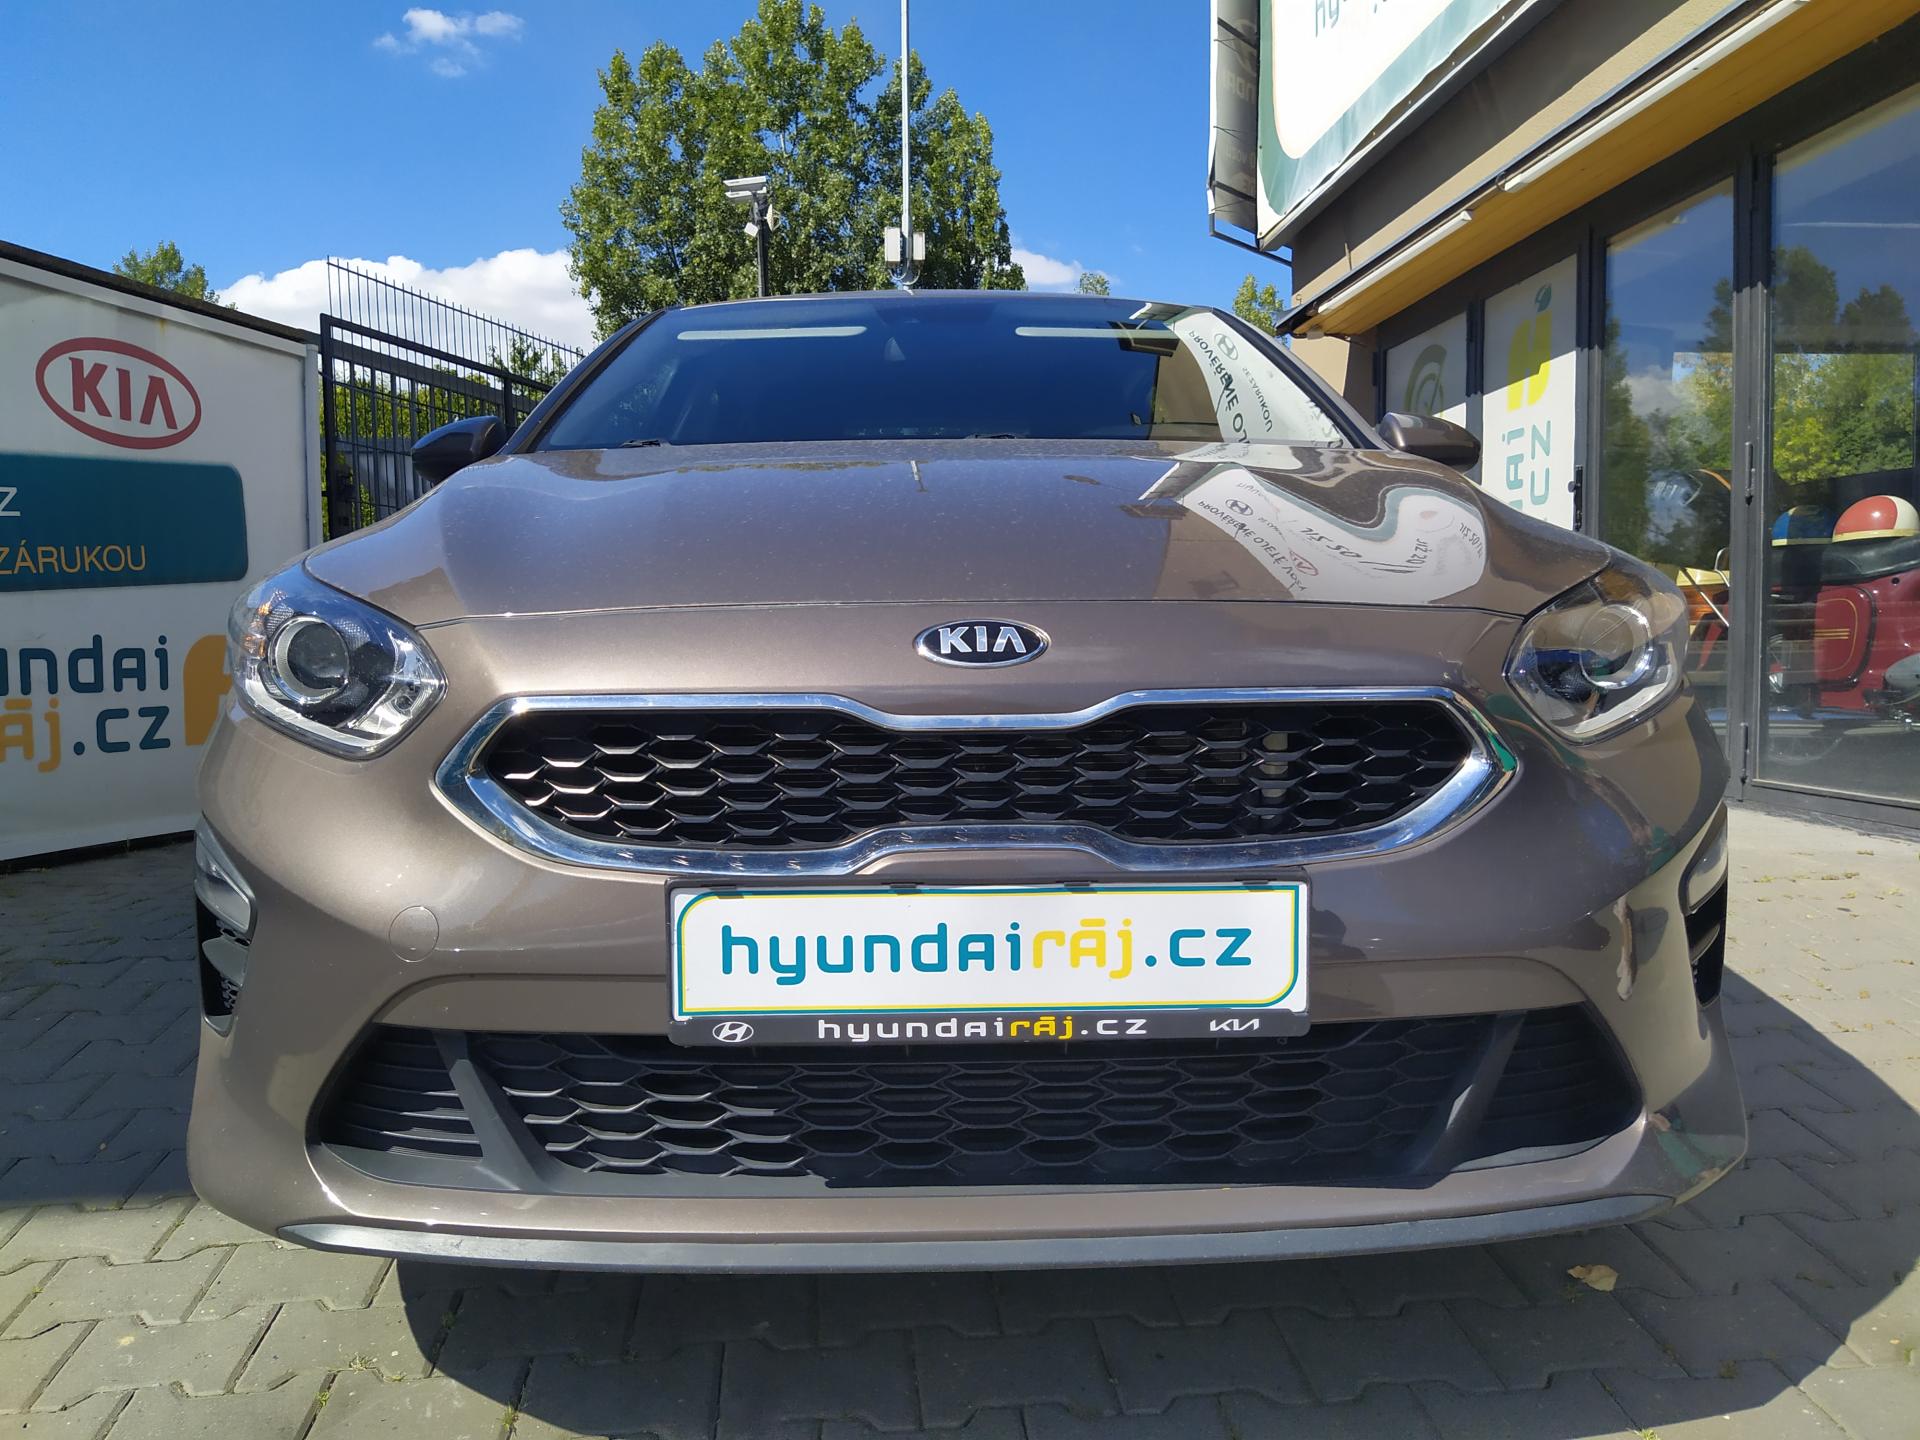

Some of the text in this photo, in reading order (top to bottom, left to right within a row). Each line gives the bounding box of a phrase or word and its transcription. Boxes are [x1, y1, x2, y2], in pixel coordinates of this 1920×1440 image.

[69, 356, 178, 430] KIA
[0, 540, 146, 575] ZÁRUKOU
[938, 625, 1027, 654] KIA
